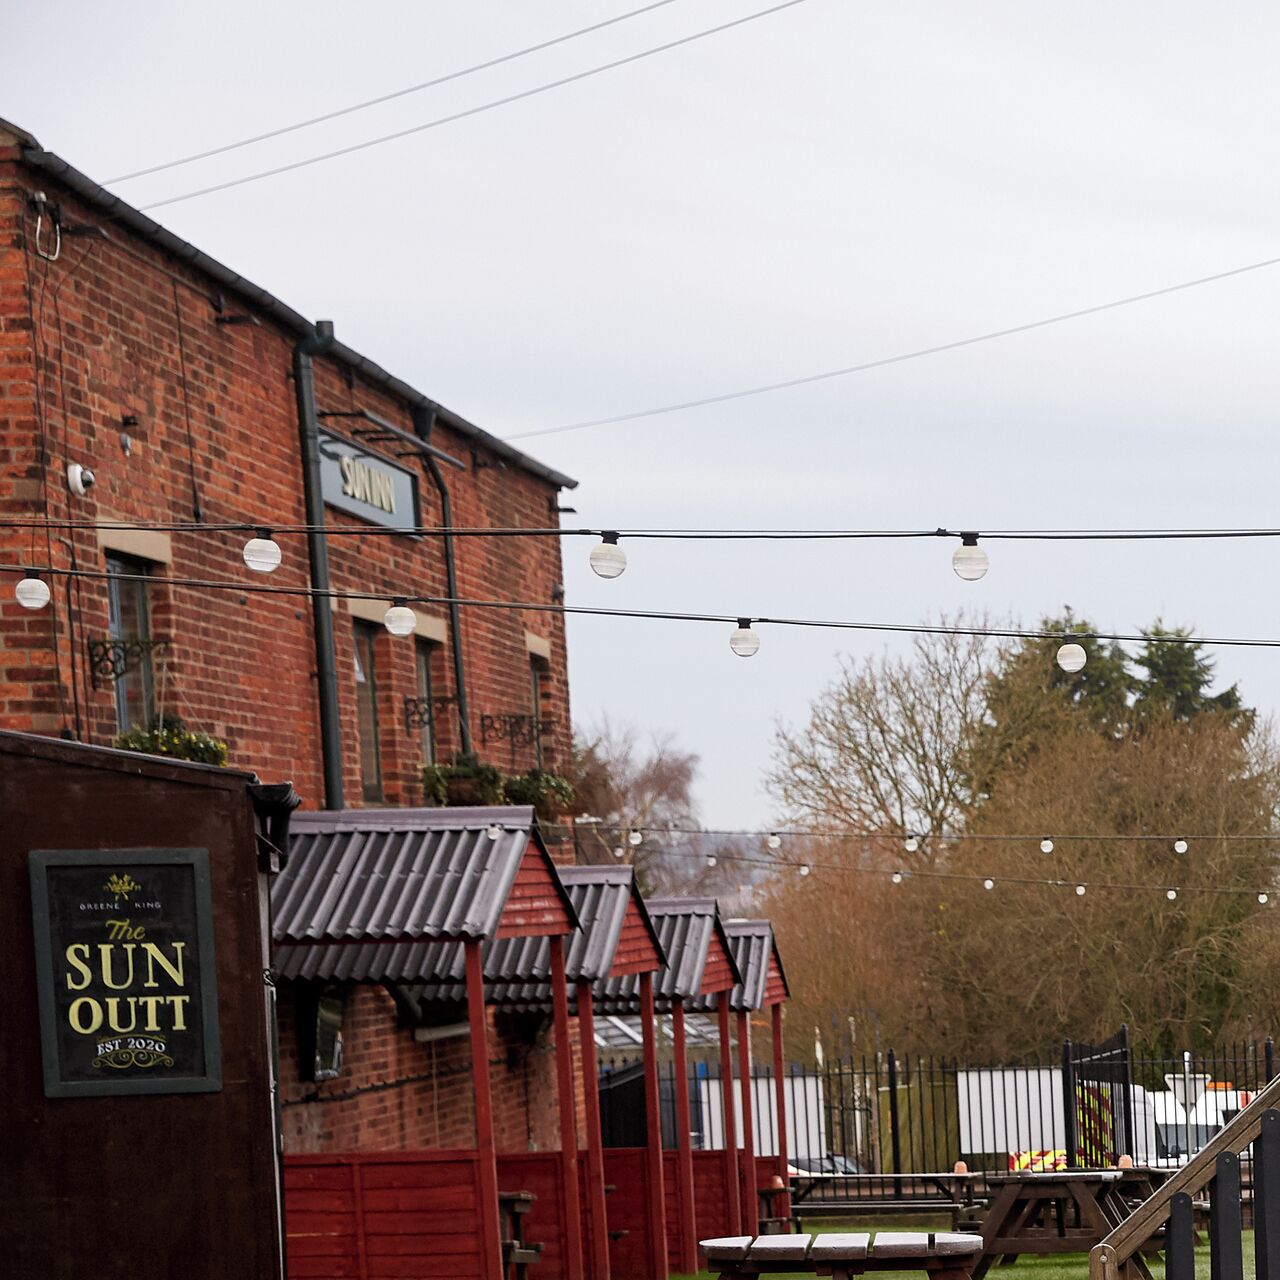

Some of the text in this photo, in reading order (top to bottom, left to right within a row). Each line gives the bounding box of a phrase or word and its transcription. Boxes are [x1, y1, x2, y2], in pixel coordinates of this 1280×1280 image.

[340, 456, 395, 514] SUN INN
[79, 900, 162, 911] GREENE KING
[105, 918, 146, 941] The
[65, 942, 186, 990] SUN
[68, 995, 190, 1035] OUTT
[96, 1037, 166, 1056] EST 2020
